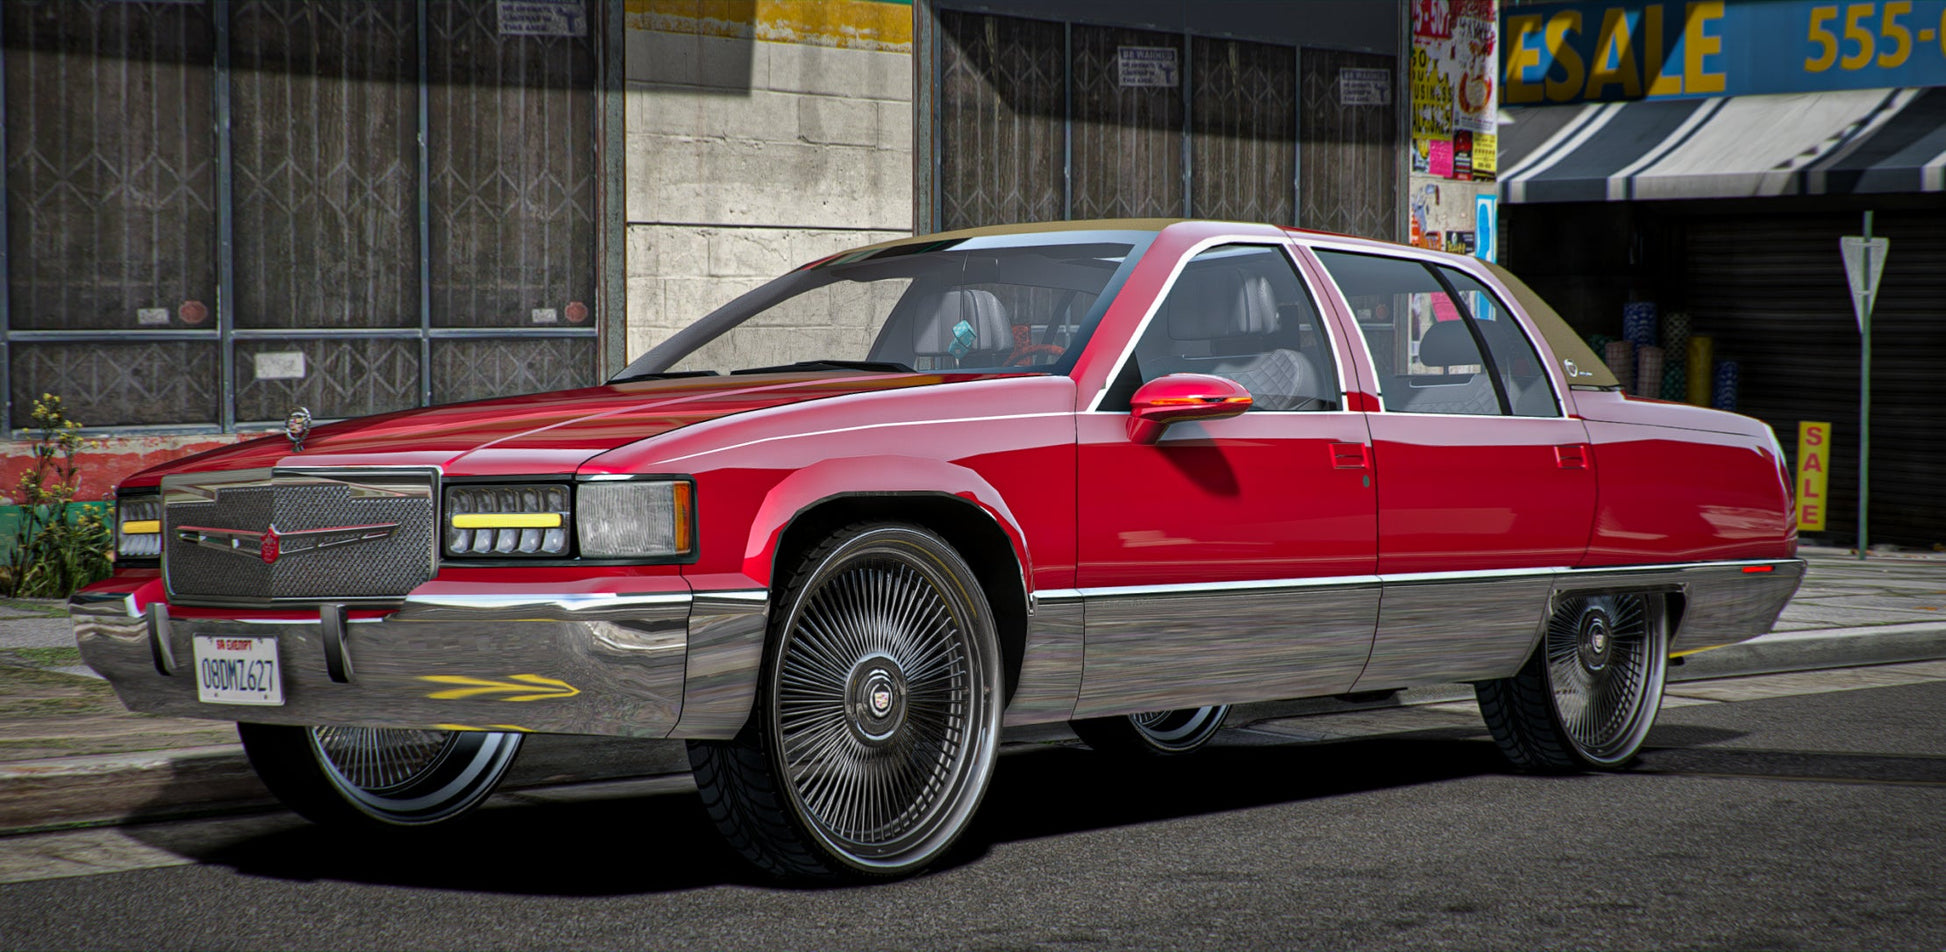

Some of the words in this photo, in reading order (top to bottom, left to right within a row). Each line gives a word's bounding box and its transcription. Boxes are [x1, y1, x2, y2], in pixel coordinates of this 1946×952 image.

[1499, 2, 1726, 104] ESALE
[1804, 1, 1946, 73] 555-
[1803, 426, 1823, 524] SALE
[202, 658, 273, 692] 08DMZ627
